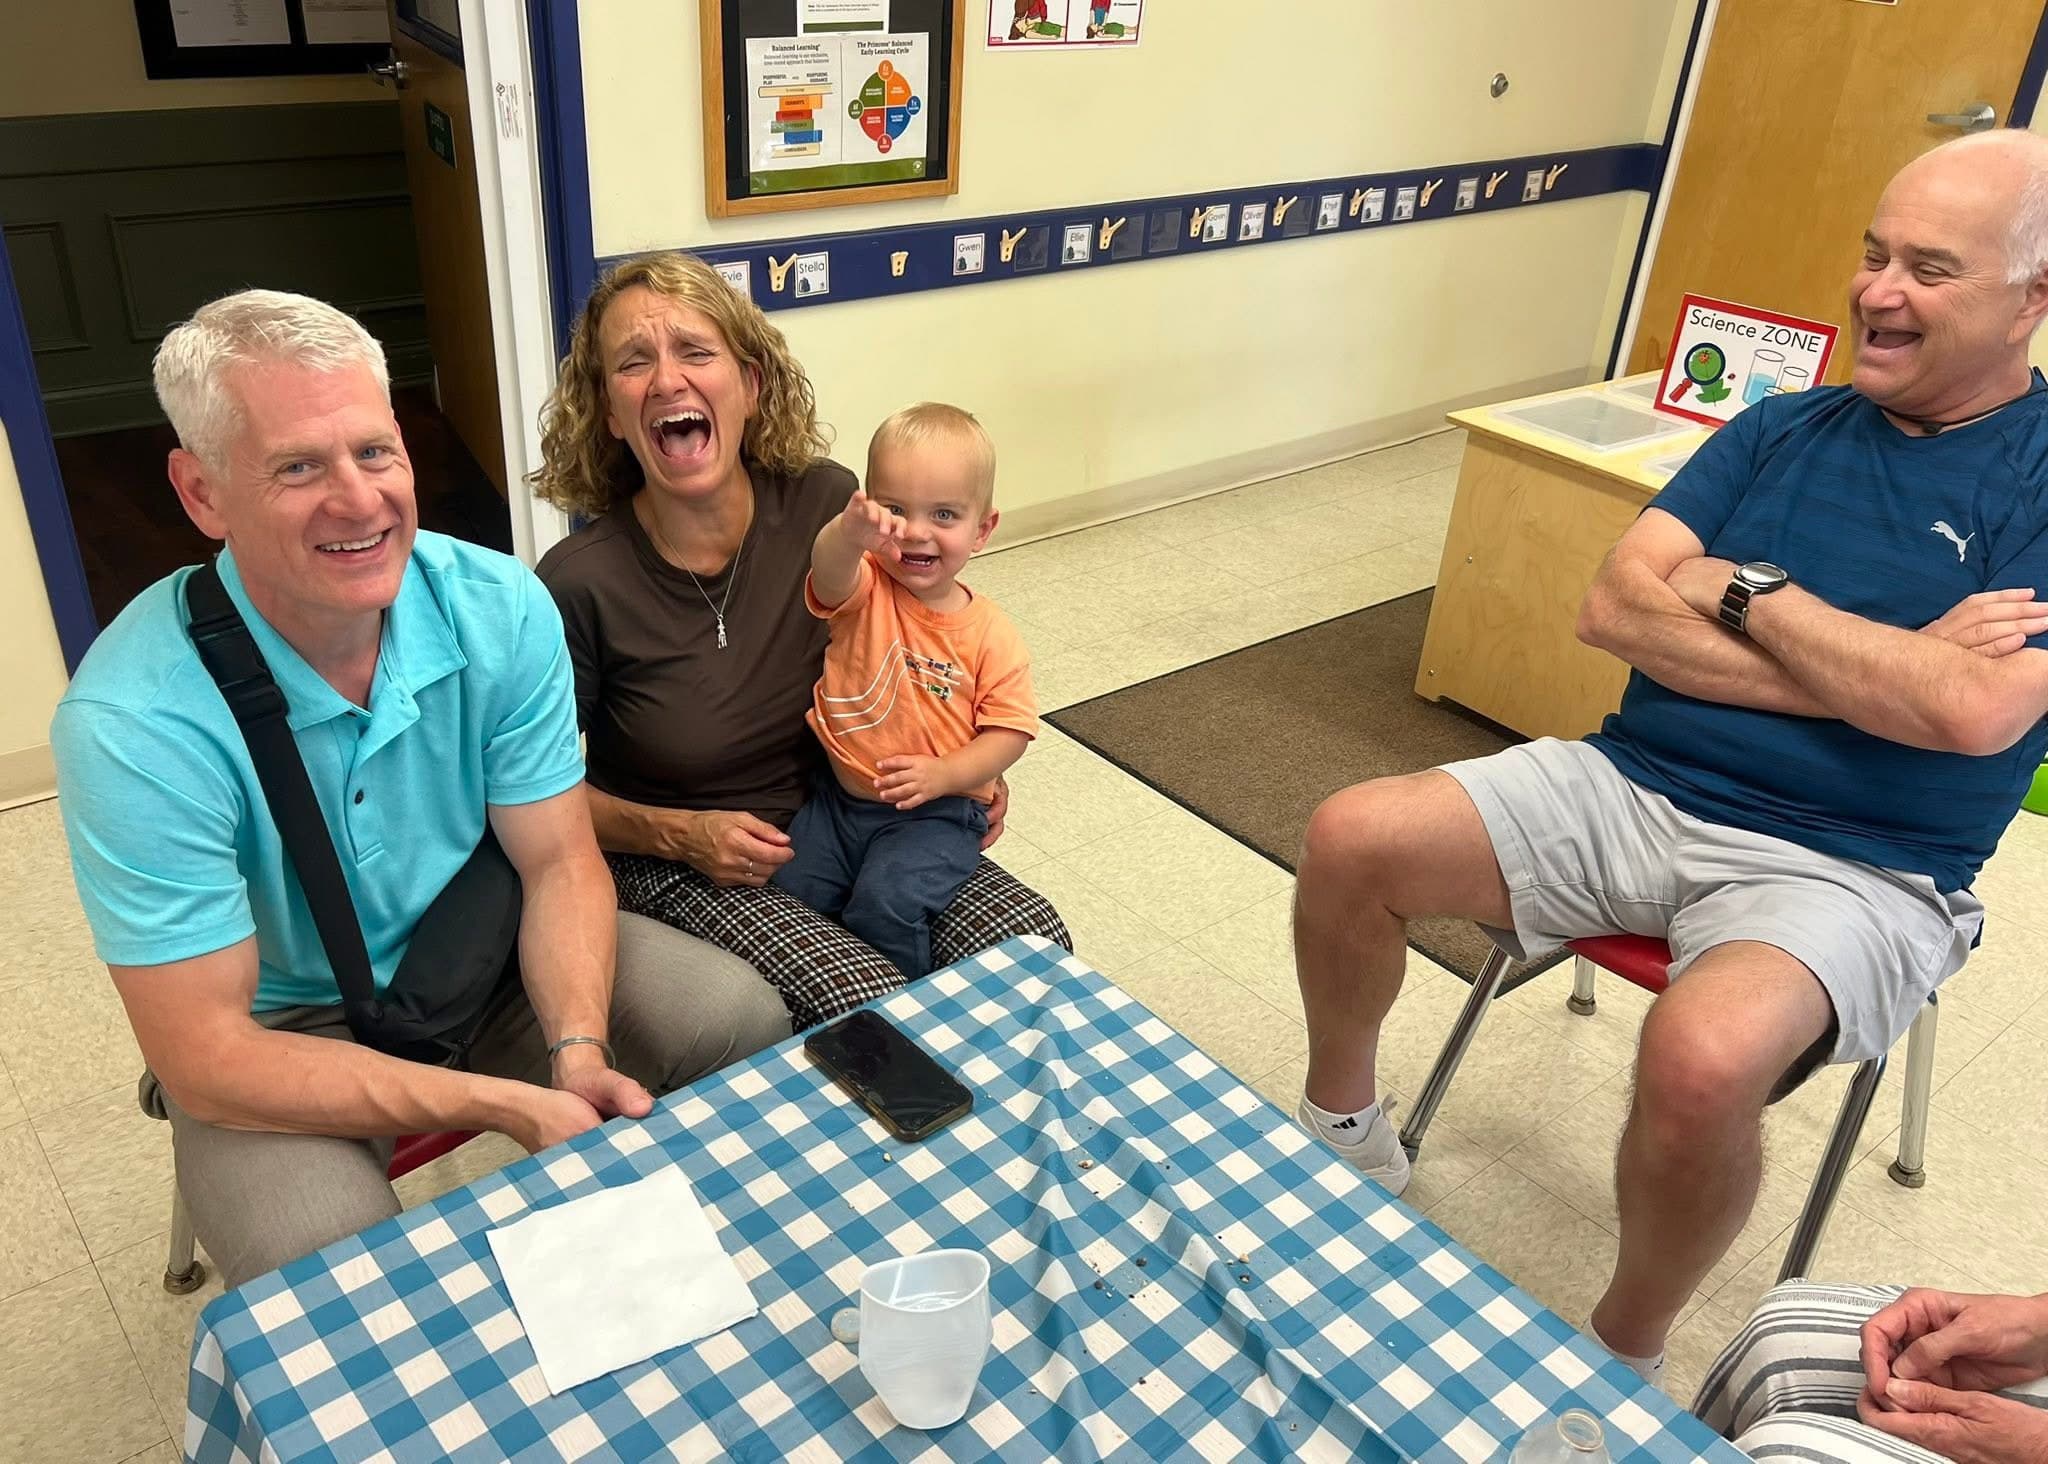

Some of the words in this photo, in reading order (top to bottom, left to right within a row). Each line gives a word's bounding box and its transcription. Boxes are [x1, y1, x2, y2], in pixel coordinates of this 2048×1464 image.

[772, 44, 795, 52] Balanced
[958, 242, 981, 253] Gwen
[799, 261, 825, 274] Stella
[721, 271, 743, 281] Evie
[1690, 309, 1757, 338] Science
[1761, 325, 1822, 353] ZONE
